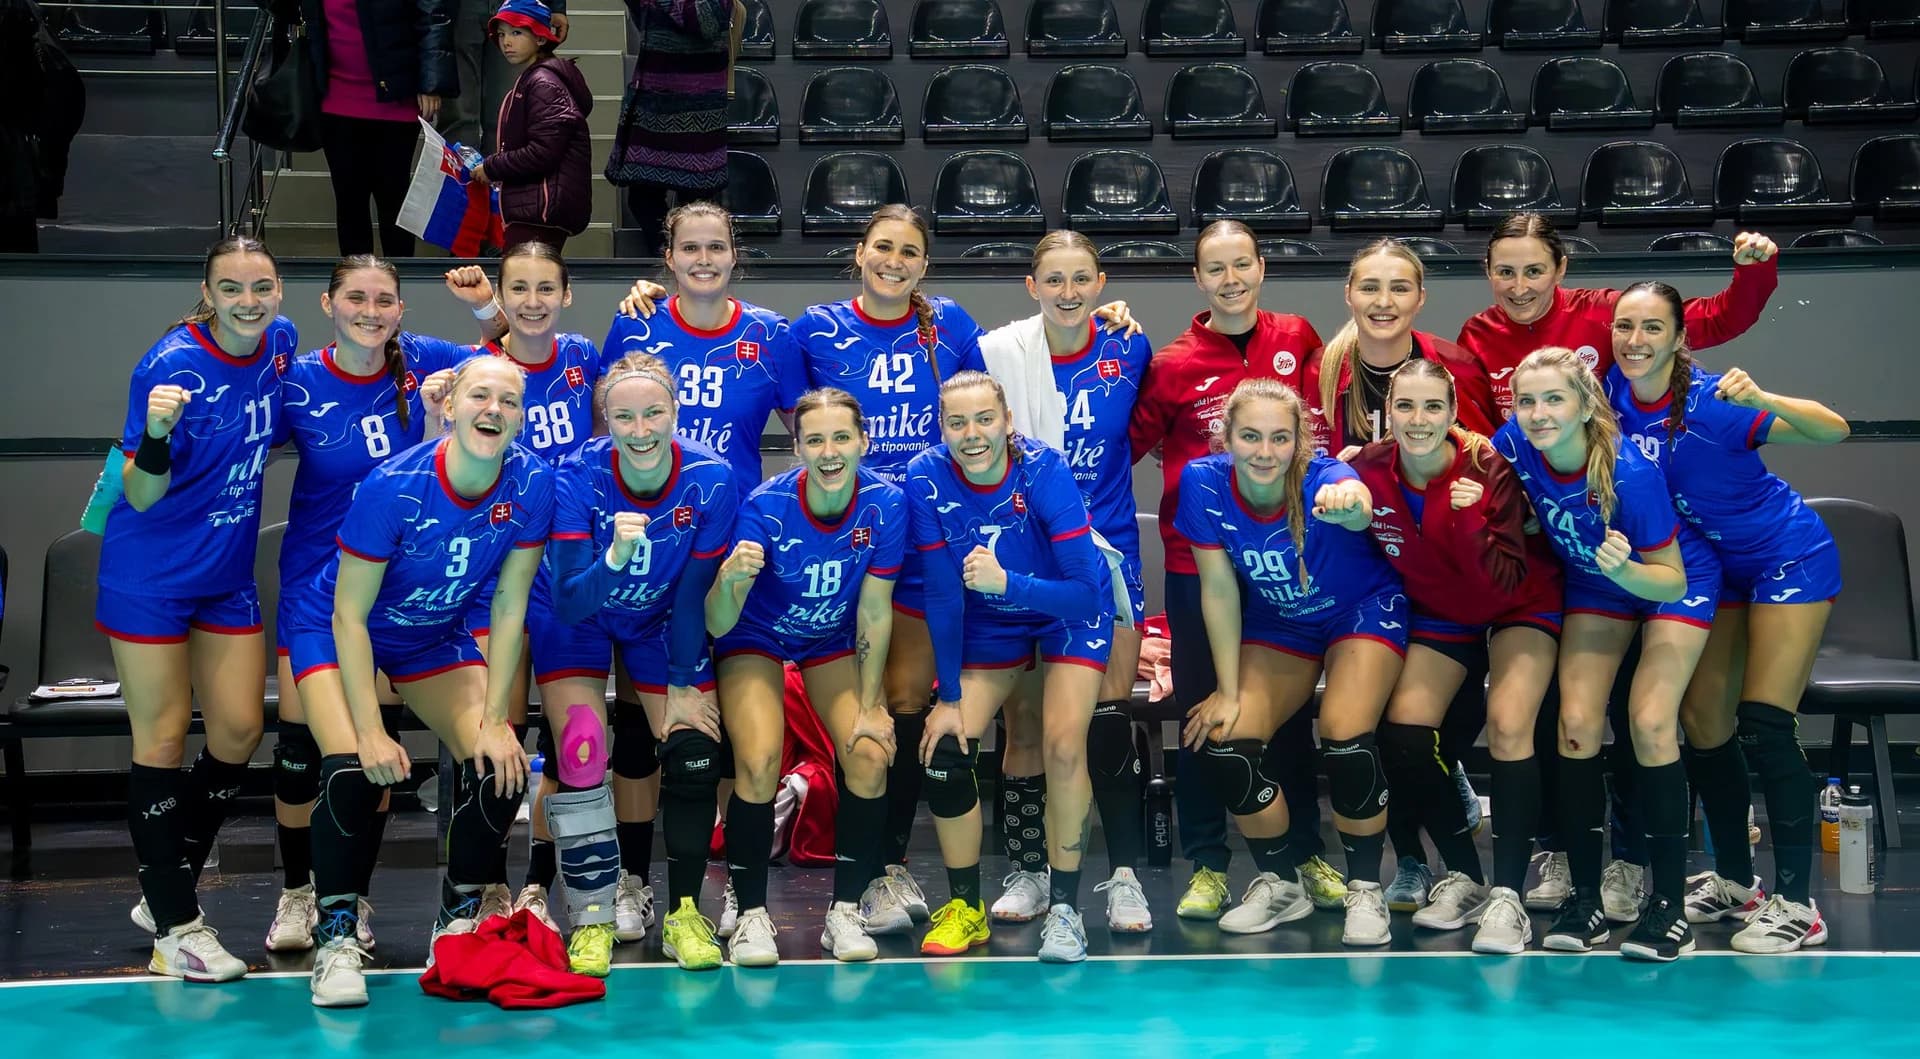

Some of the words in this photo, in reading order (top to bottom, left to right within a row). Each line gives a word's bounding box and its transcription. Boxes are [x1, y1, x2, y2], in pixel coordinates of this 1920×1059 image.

[679, 364, 724, 408] 33
[868, 353, 916, 394] 42
[244, 394, 273, 444] 11
[360, 414, 391, 458] 8
[528, 401, 575, 449] 38
[867, 402, 933, 438] niké
[869, 442, 880, 455] je
[881, 440, 930, 455] tipovanie
[445, 537, 471, 577] 3
[629, 536, 651, 576] 9
[980, 525, 1002, 560] 7
[801, 560, 842, 599] 18
[1243, 550, 1293, 582] 29
